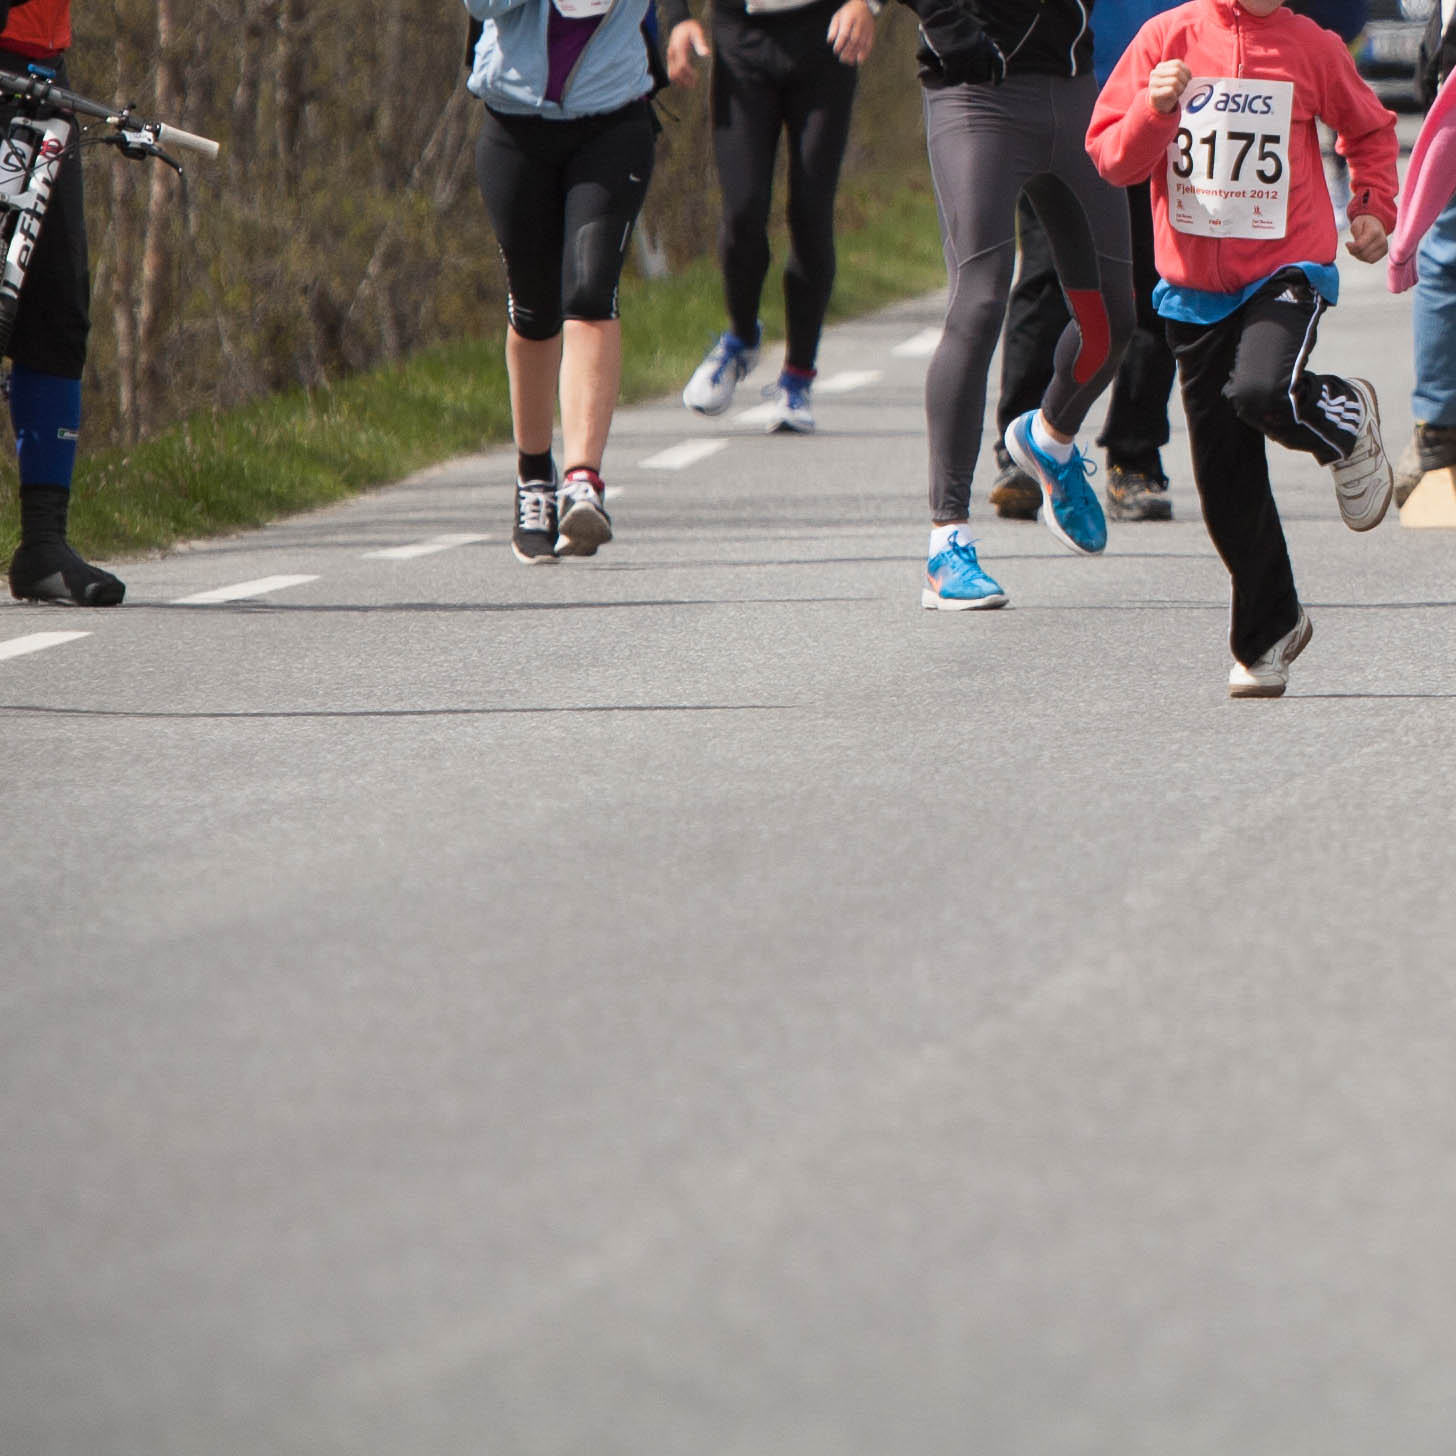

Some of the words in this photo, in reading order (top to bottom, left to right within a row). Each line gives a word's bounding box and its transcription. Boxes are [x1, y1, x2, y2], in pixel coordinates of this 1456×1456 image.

[1214, 93, 1273, 114] asics
[1172, 127, 1283, 184] 3175
[1176, 184, 1246, 200] Fjelleventyret
[1249, 189, 1278, 200] 2012
